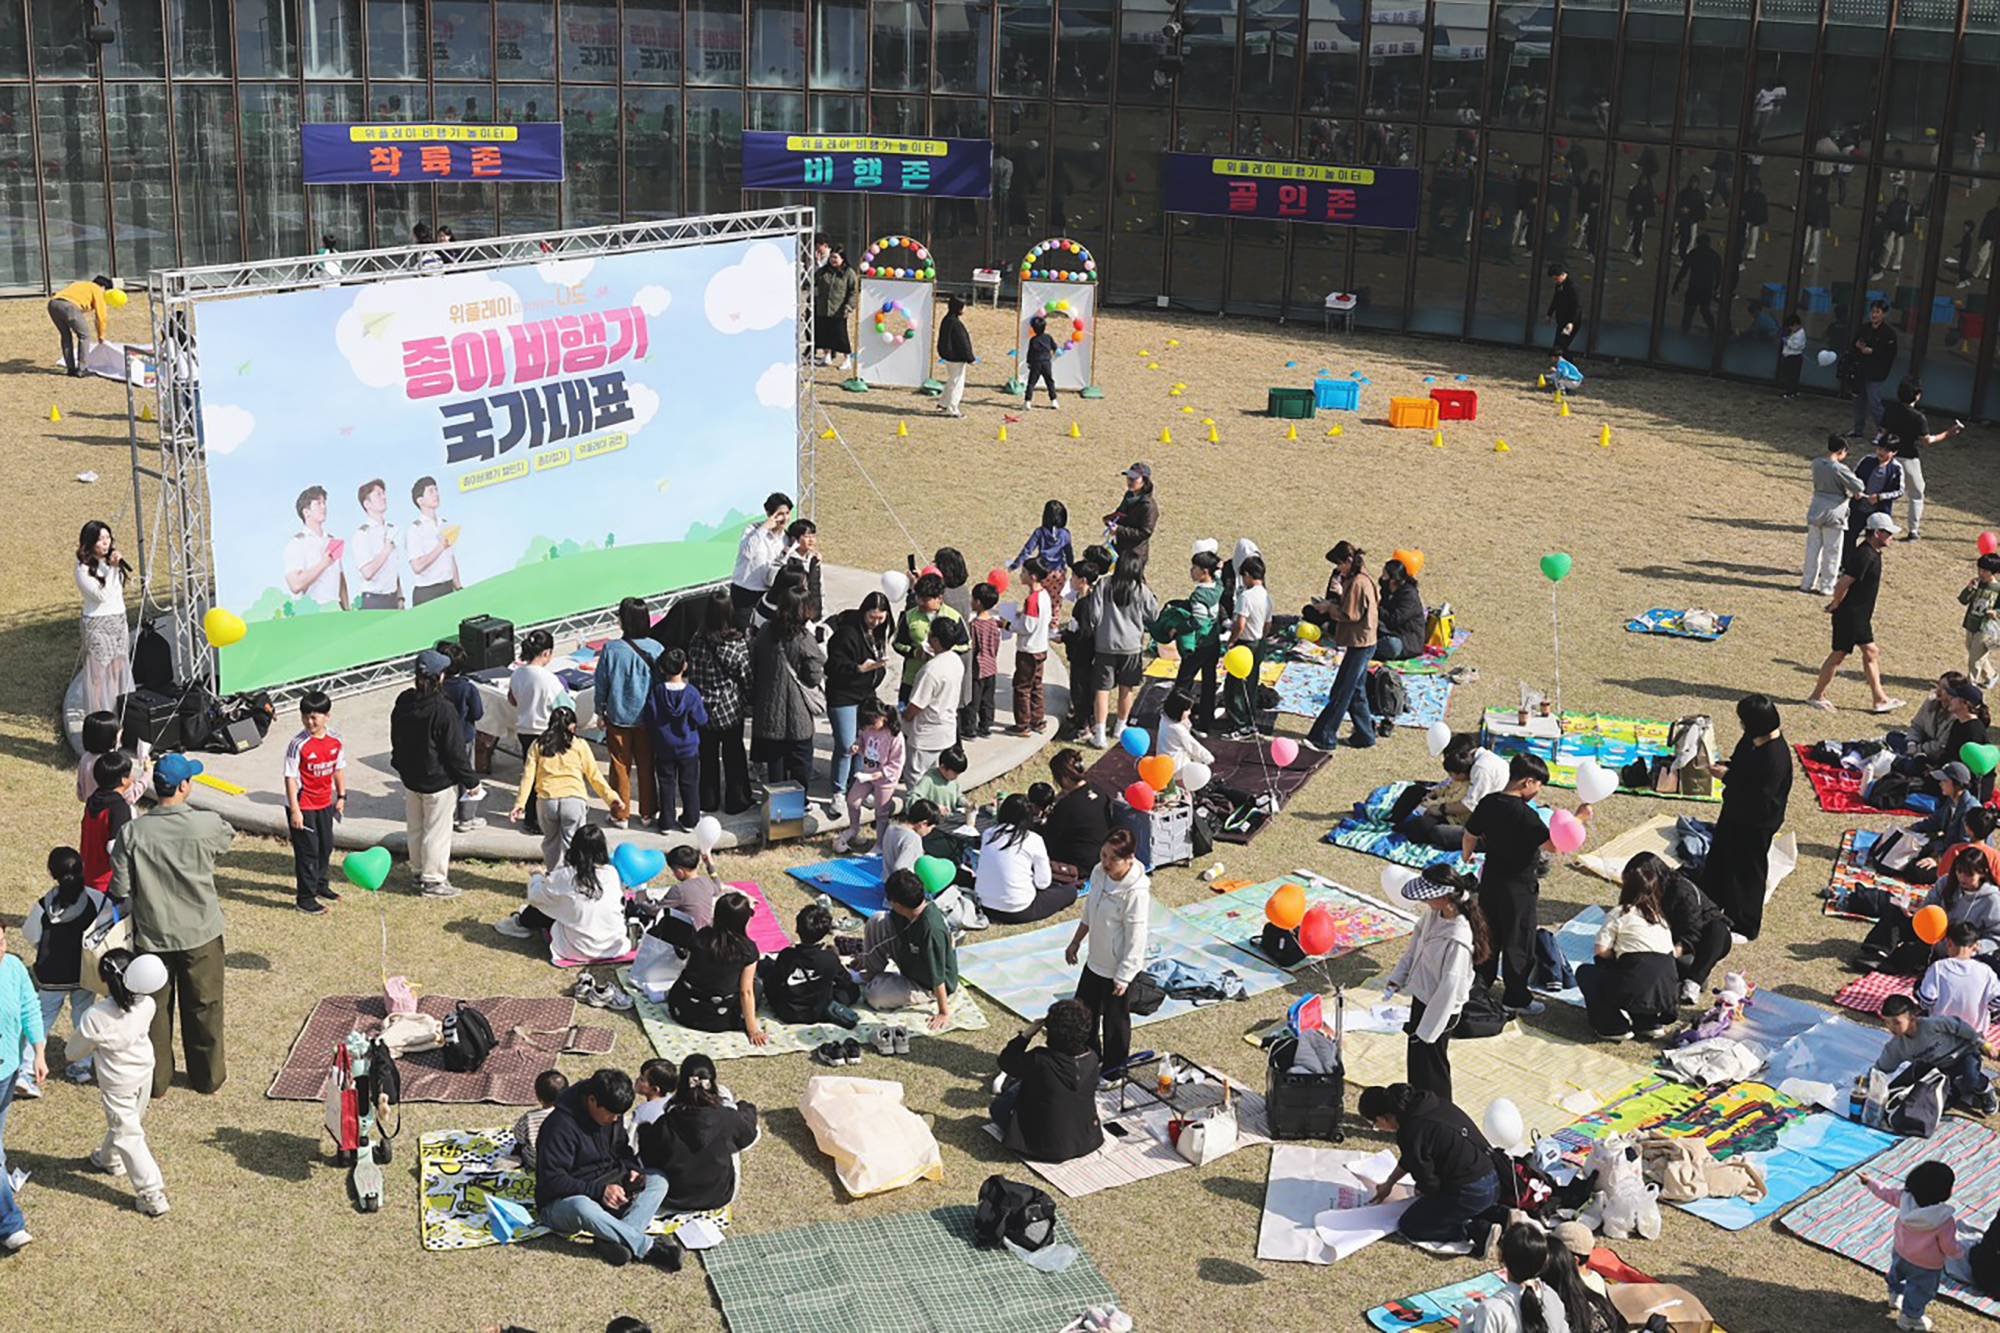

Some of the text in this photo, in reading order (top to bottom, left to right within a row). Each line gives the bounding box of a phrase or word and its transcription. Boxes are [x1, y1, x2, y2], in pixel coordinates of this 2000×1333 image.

[364, 127, 504, 139] 위플레이 비행기 놀이터
[801, 138, 935, 154] 위플레이 비행기 놀이터
[1227, 161, 1362, 182] 위플레이 비행기 놀이터
[438, 370, 635, 465] 국가대표
